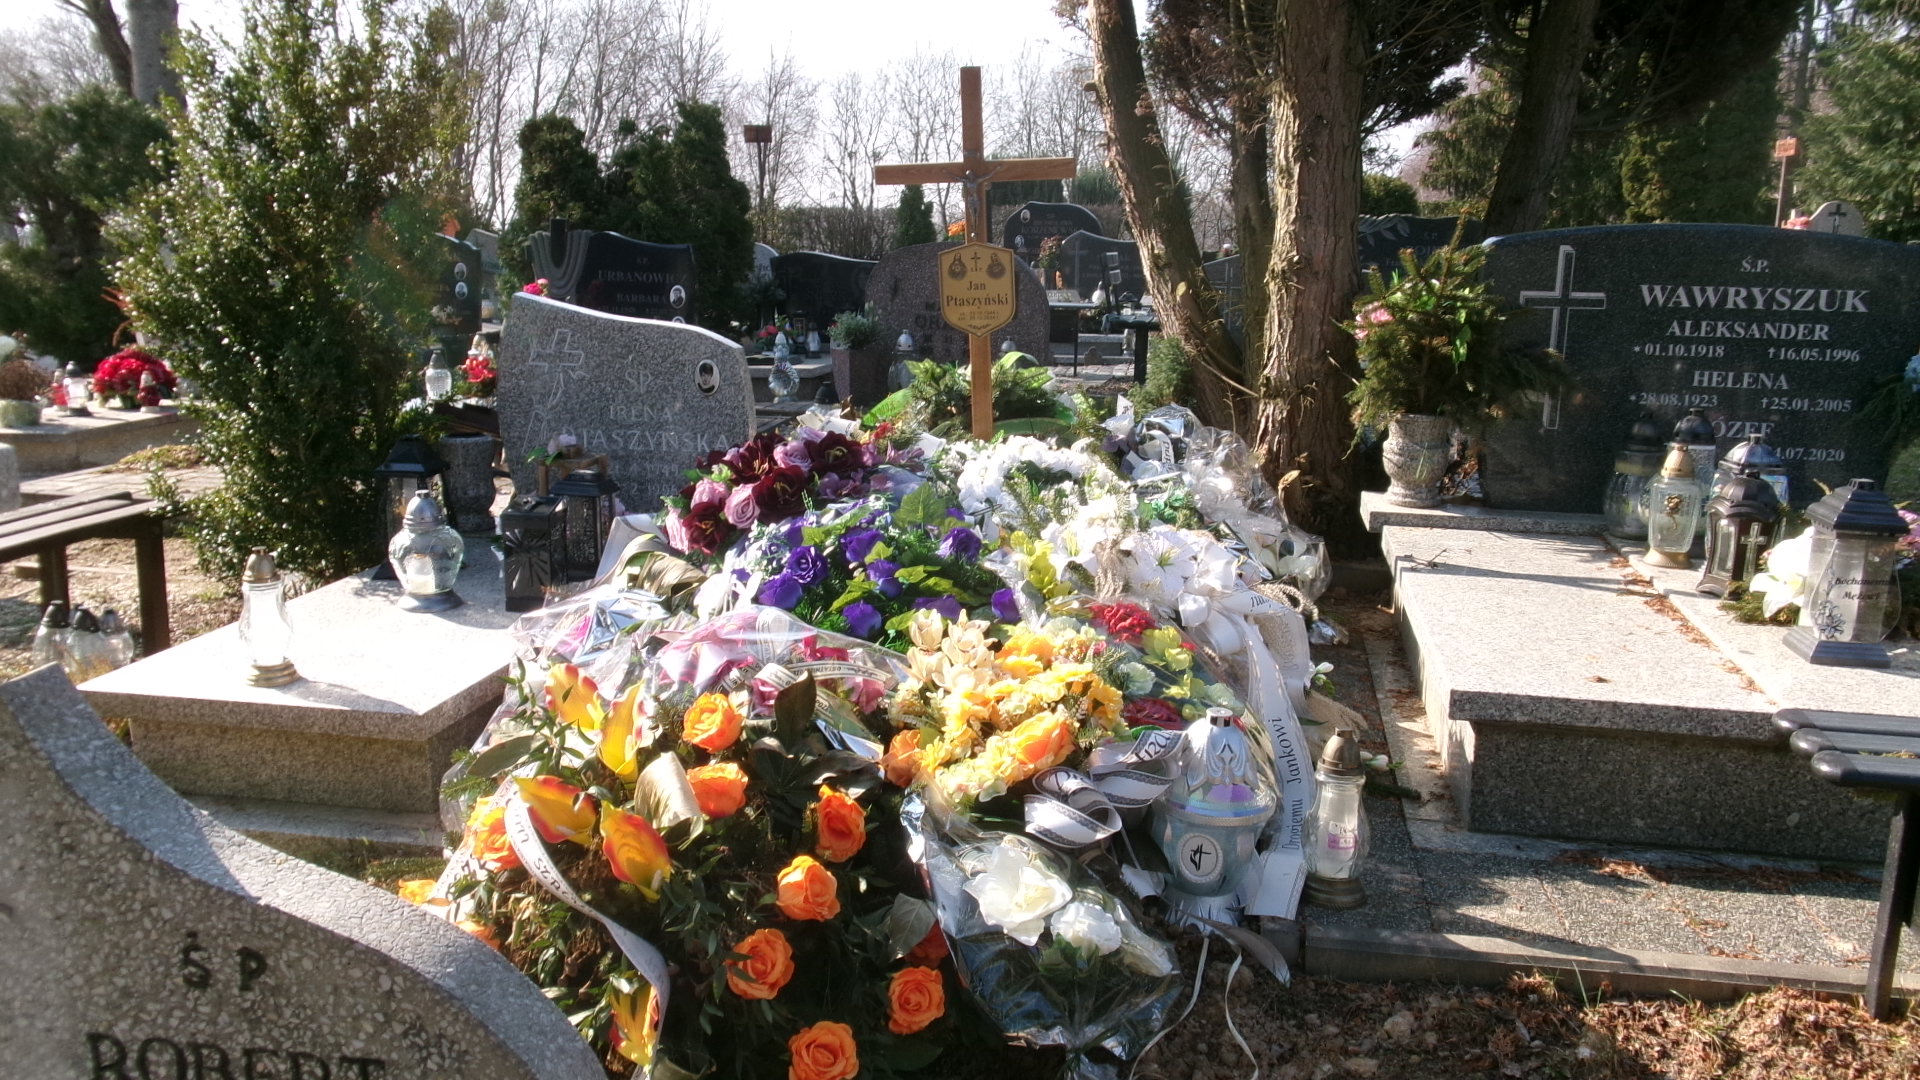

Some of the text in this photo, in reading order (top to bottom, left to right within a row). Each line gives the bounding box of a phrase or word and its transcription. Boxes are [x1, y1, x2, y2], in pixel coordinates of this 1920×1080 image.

[966, 280, 987, 291] Jan
[945, 293, 1009, 309] Ptaszyński
[1639, 284, 1870, 314] WAWRYSZUK
[1665, 319, 1831, 342] ALEKSANDER
[1692, 370, 1790, 390] HELENA
[609, 405, 673, 422] IRENA
[1711, 415, 1775, 439] ÓZEF
[1267, 717, 1304, 785] Jankowi
